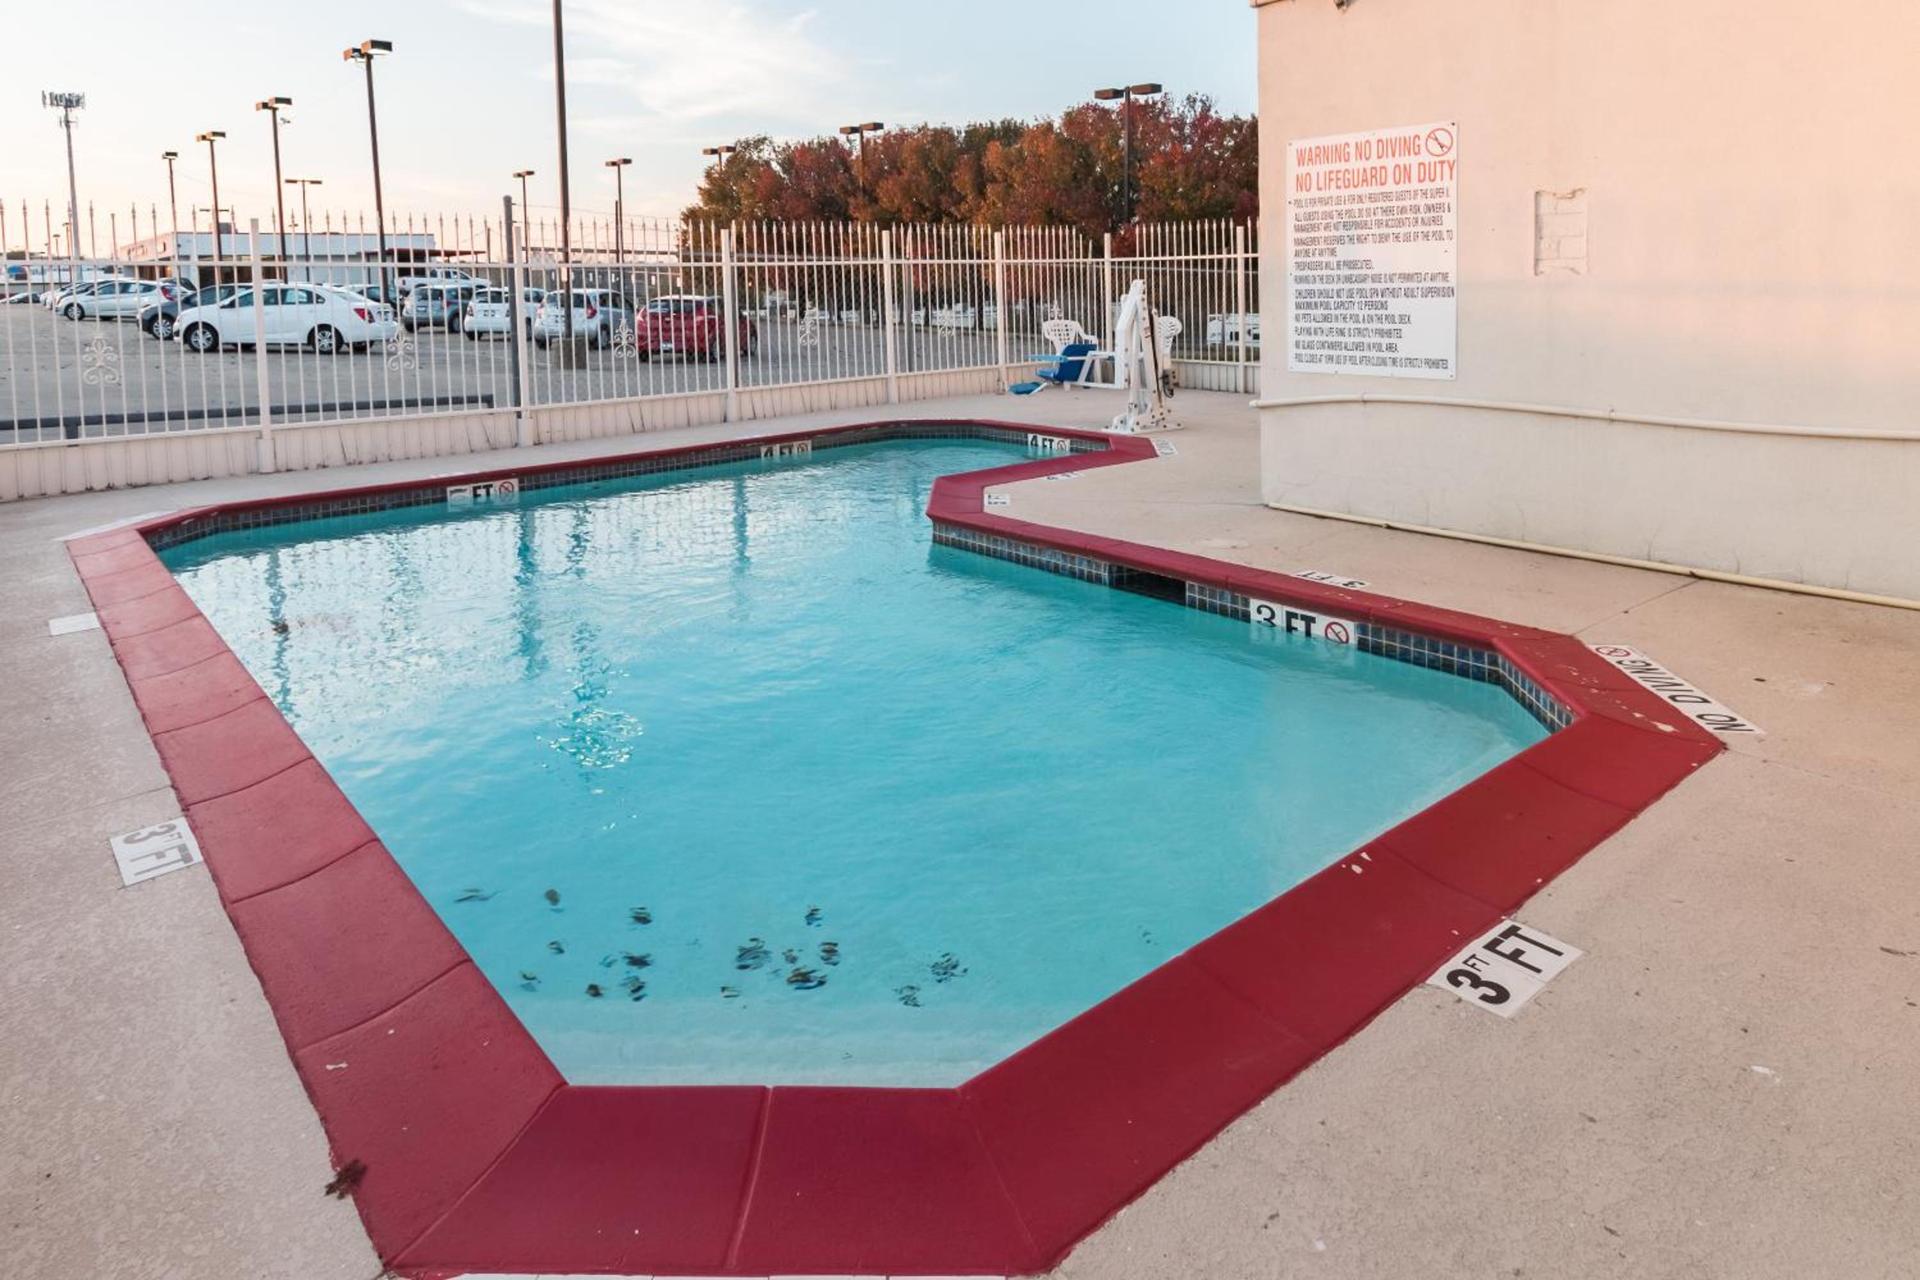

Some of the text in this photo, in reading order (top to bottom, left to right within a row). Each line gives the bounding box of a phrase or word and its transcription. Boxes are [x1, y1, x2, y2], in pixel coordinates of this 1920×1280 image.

[1296, 134, 1421, 167] WARNING NO DIVING
[1296, 159, 1455, 193] NO LIFEGUARD ON DUTY
[1303, 211, 1319, 222] GUESTS
[1345, 208, 1357, 219] POOL
[1424, 202, 1445, 215] OWNERS
[1334, 301, 1356, 310] CAPACITY
[1030, 435, 1054, 449] 4 FT
[472, 483, 494, 498] FT
[1256, 604, 1317, 637] 3 FT
[1616, 659, 1755, 732] NO DIVING
[123, 823, 177, 844] 3
[129, 843, 194, 876] FT
[1446, 924, 1565, 1005] 3 FT FT
